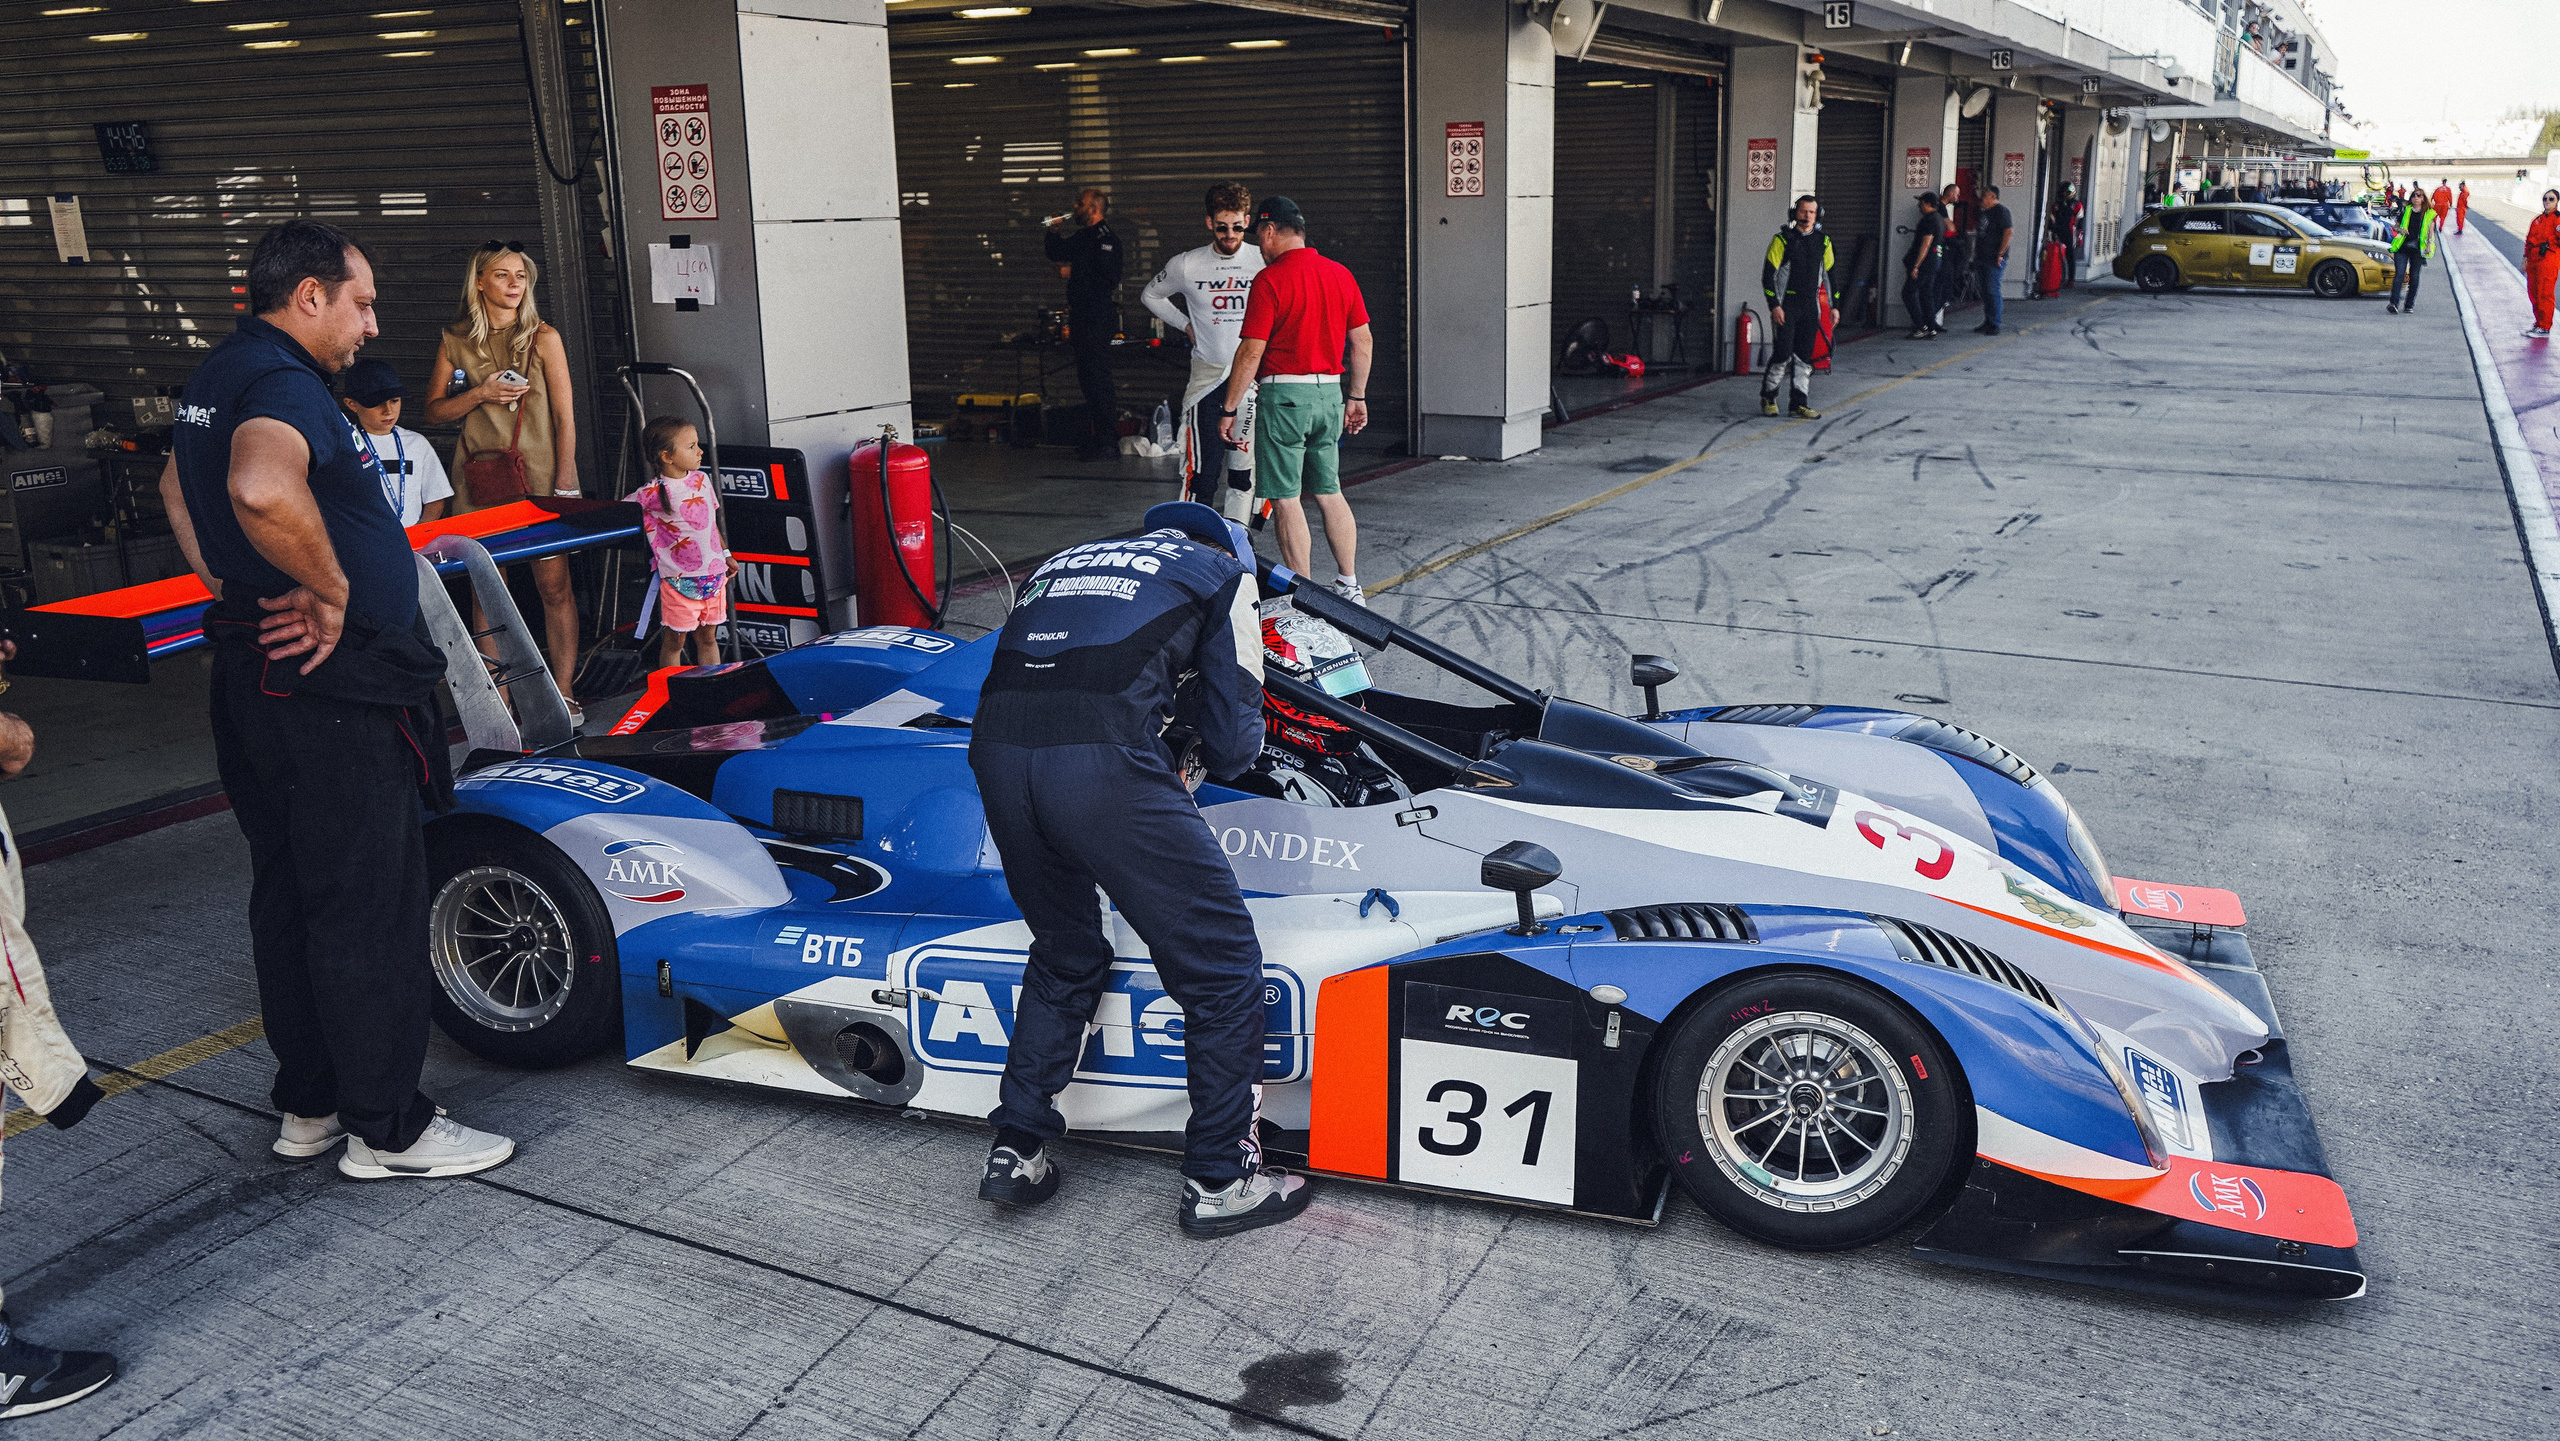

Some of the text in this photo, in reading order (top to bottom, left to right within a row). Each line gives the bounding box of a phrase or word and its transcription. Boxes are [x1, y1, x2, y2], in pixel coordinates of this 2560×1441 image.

[1827, 4, 1848, 25] 15
[1992, 52, 2010, 67] 16
[653, 94, 708, 104] ПОВЫШЕННОЙ
[669, 88, 690, 96] ЗОНА
[659, 103, 705, 112] ОПАСНОСТИ
[1212, 295, 1245, 310] am
[1242, 397, 1254, 436] AIRLINE
[14, 470, 64, 488] AIMOL
[1049, 575, 1141, 596] БИОКОМПЛЕКС
[1027, 631, 1069, 642] SHONX.RU
[1313, 659, 1350, 677] MAGNUM
[1209, 824, 1365, 872] ONDEX
[604, 858, 685, 887] AMK
[802, 933, 865, 968] ВТБ
[1418, 1079, 1553, 1167] 31
[2209, 1172, 2247, 1219] AMK
